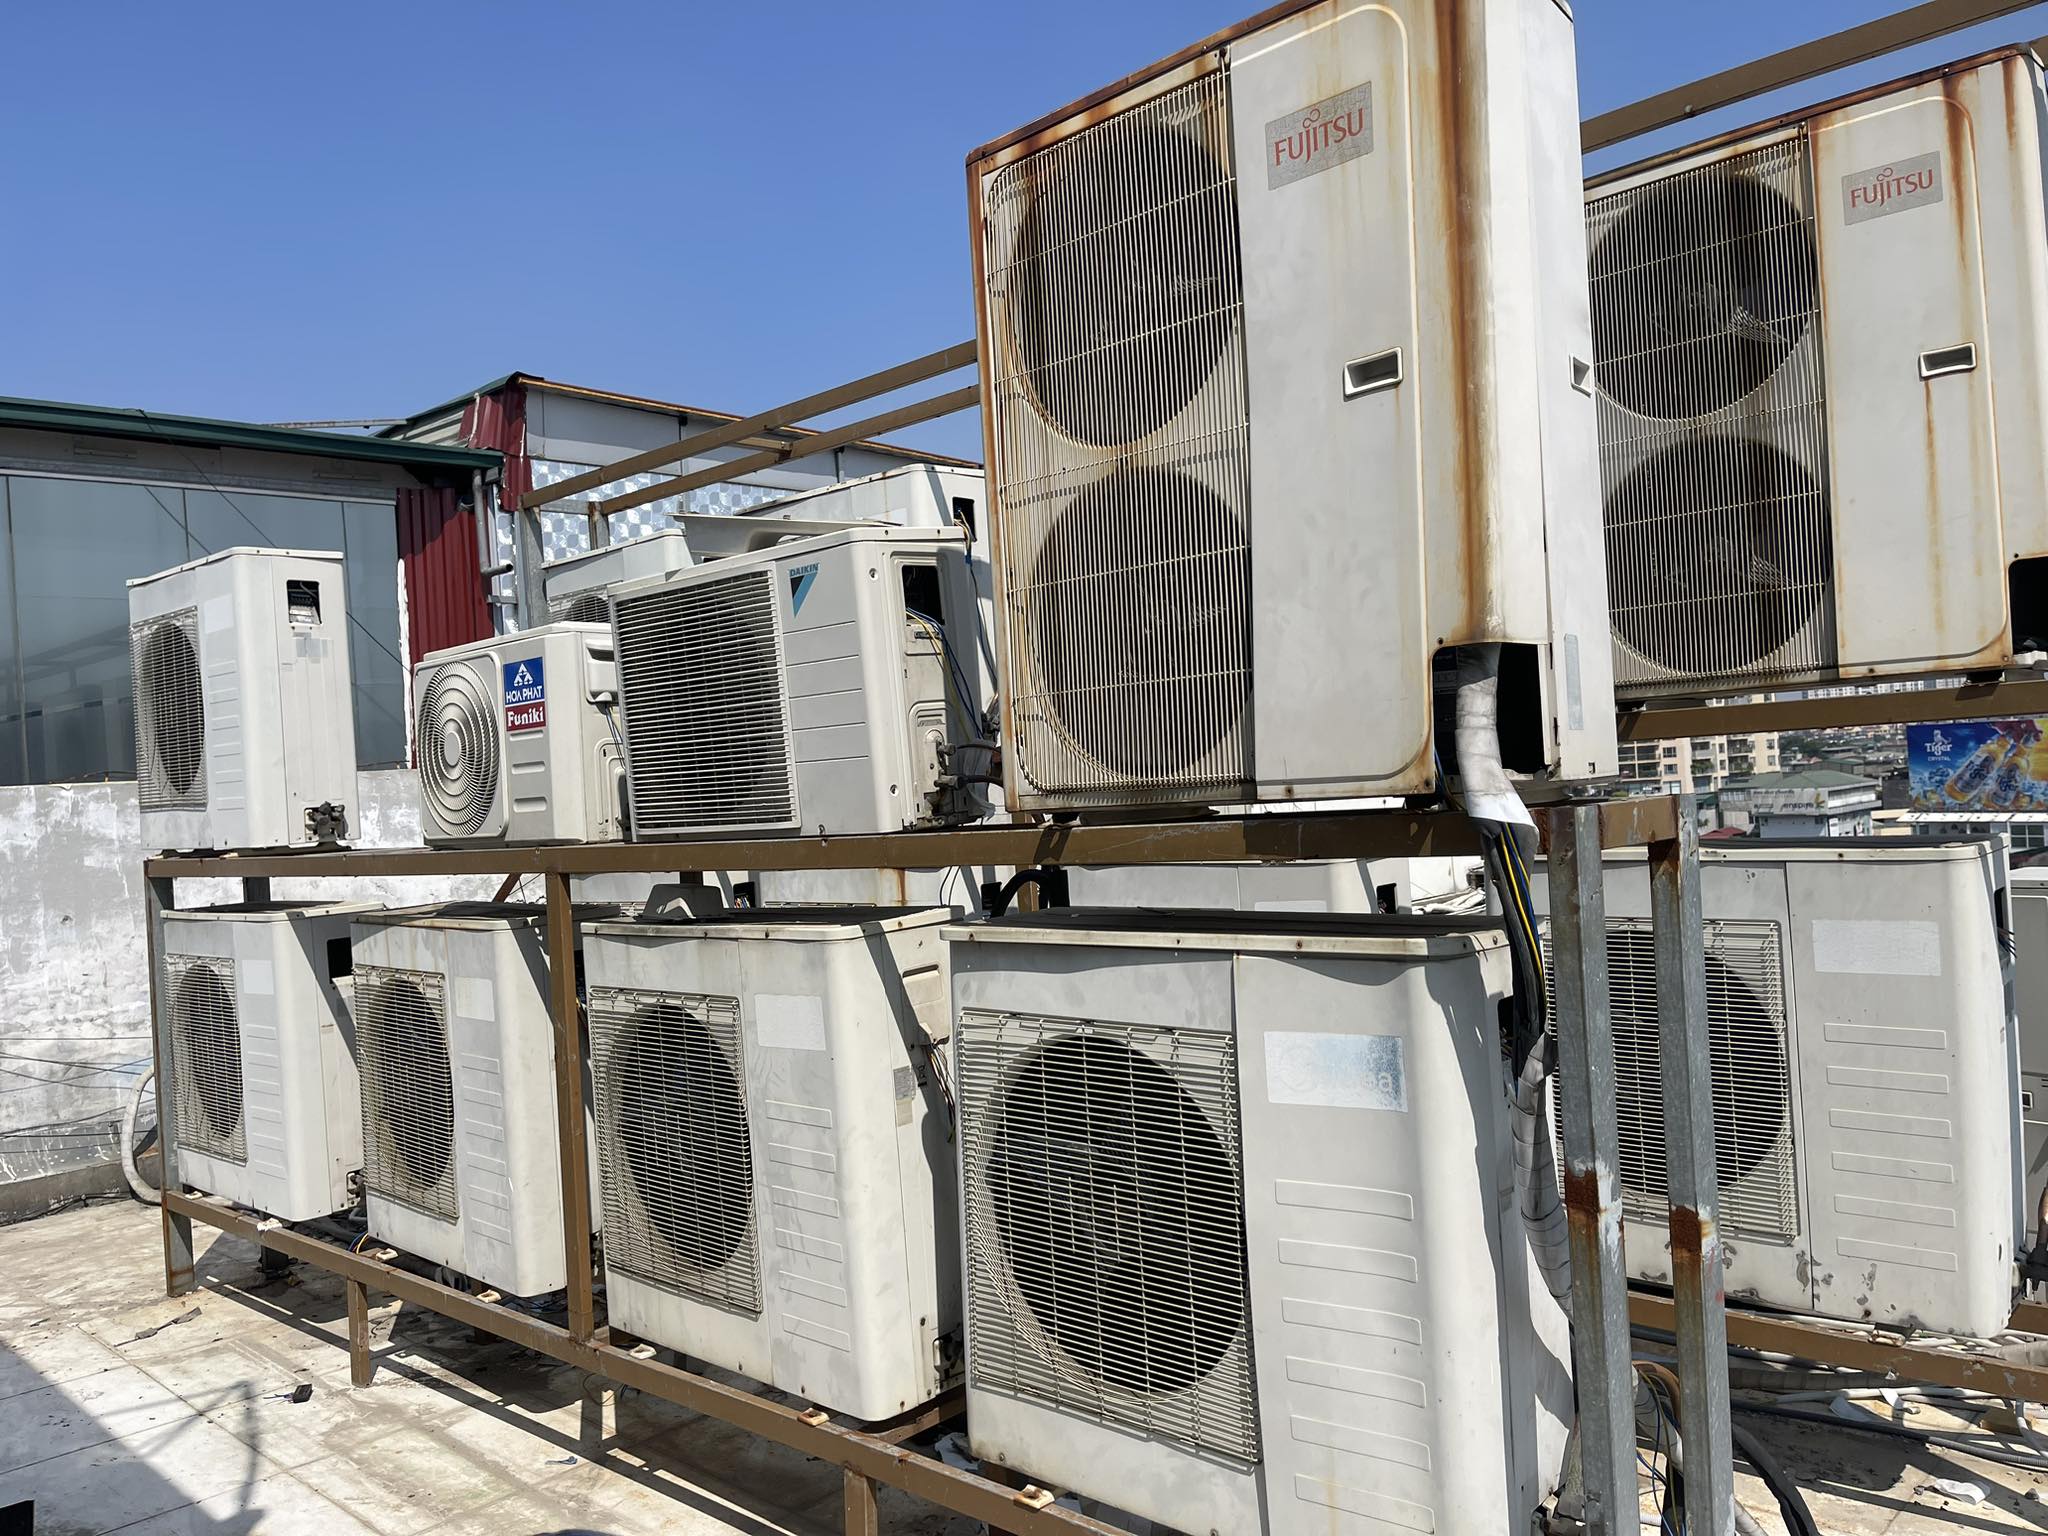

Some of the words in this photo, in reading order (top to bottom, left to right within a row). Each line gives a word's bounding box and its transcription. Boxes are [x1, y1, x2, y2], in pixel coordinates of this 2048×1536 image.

[1274, 107, 1365, 166] FUJITSU
[1850, 168, 1934, 208] FUJITSU
[788, 562, 820, 577] DAIKIN
[507, 706, 545, 727] Funiki
[1924, 742, 1952, 756] Tiger
